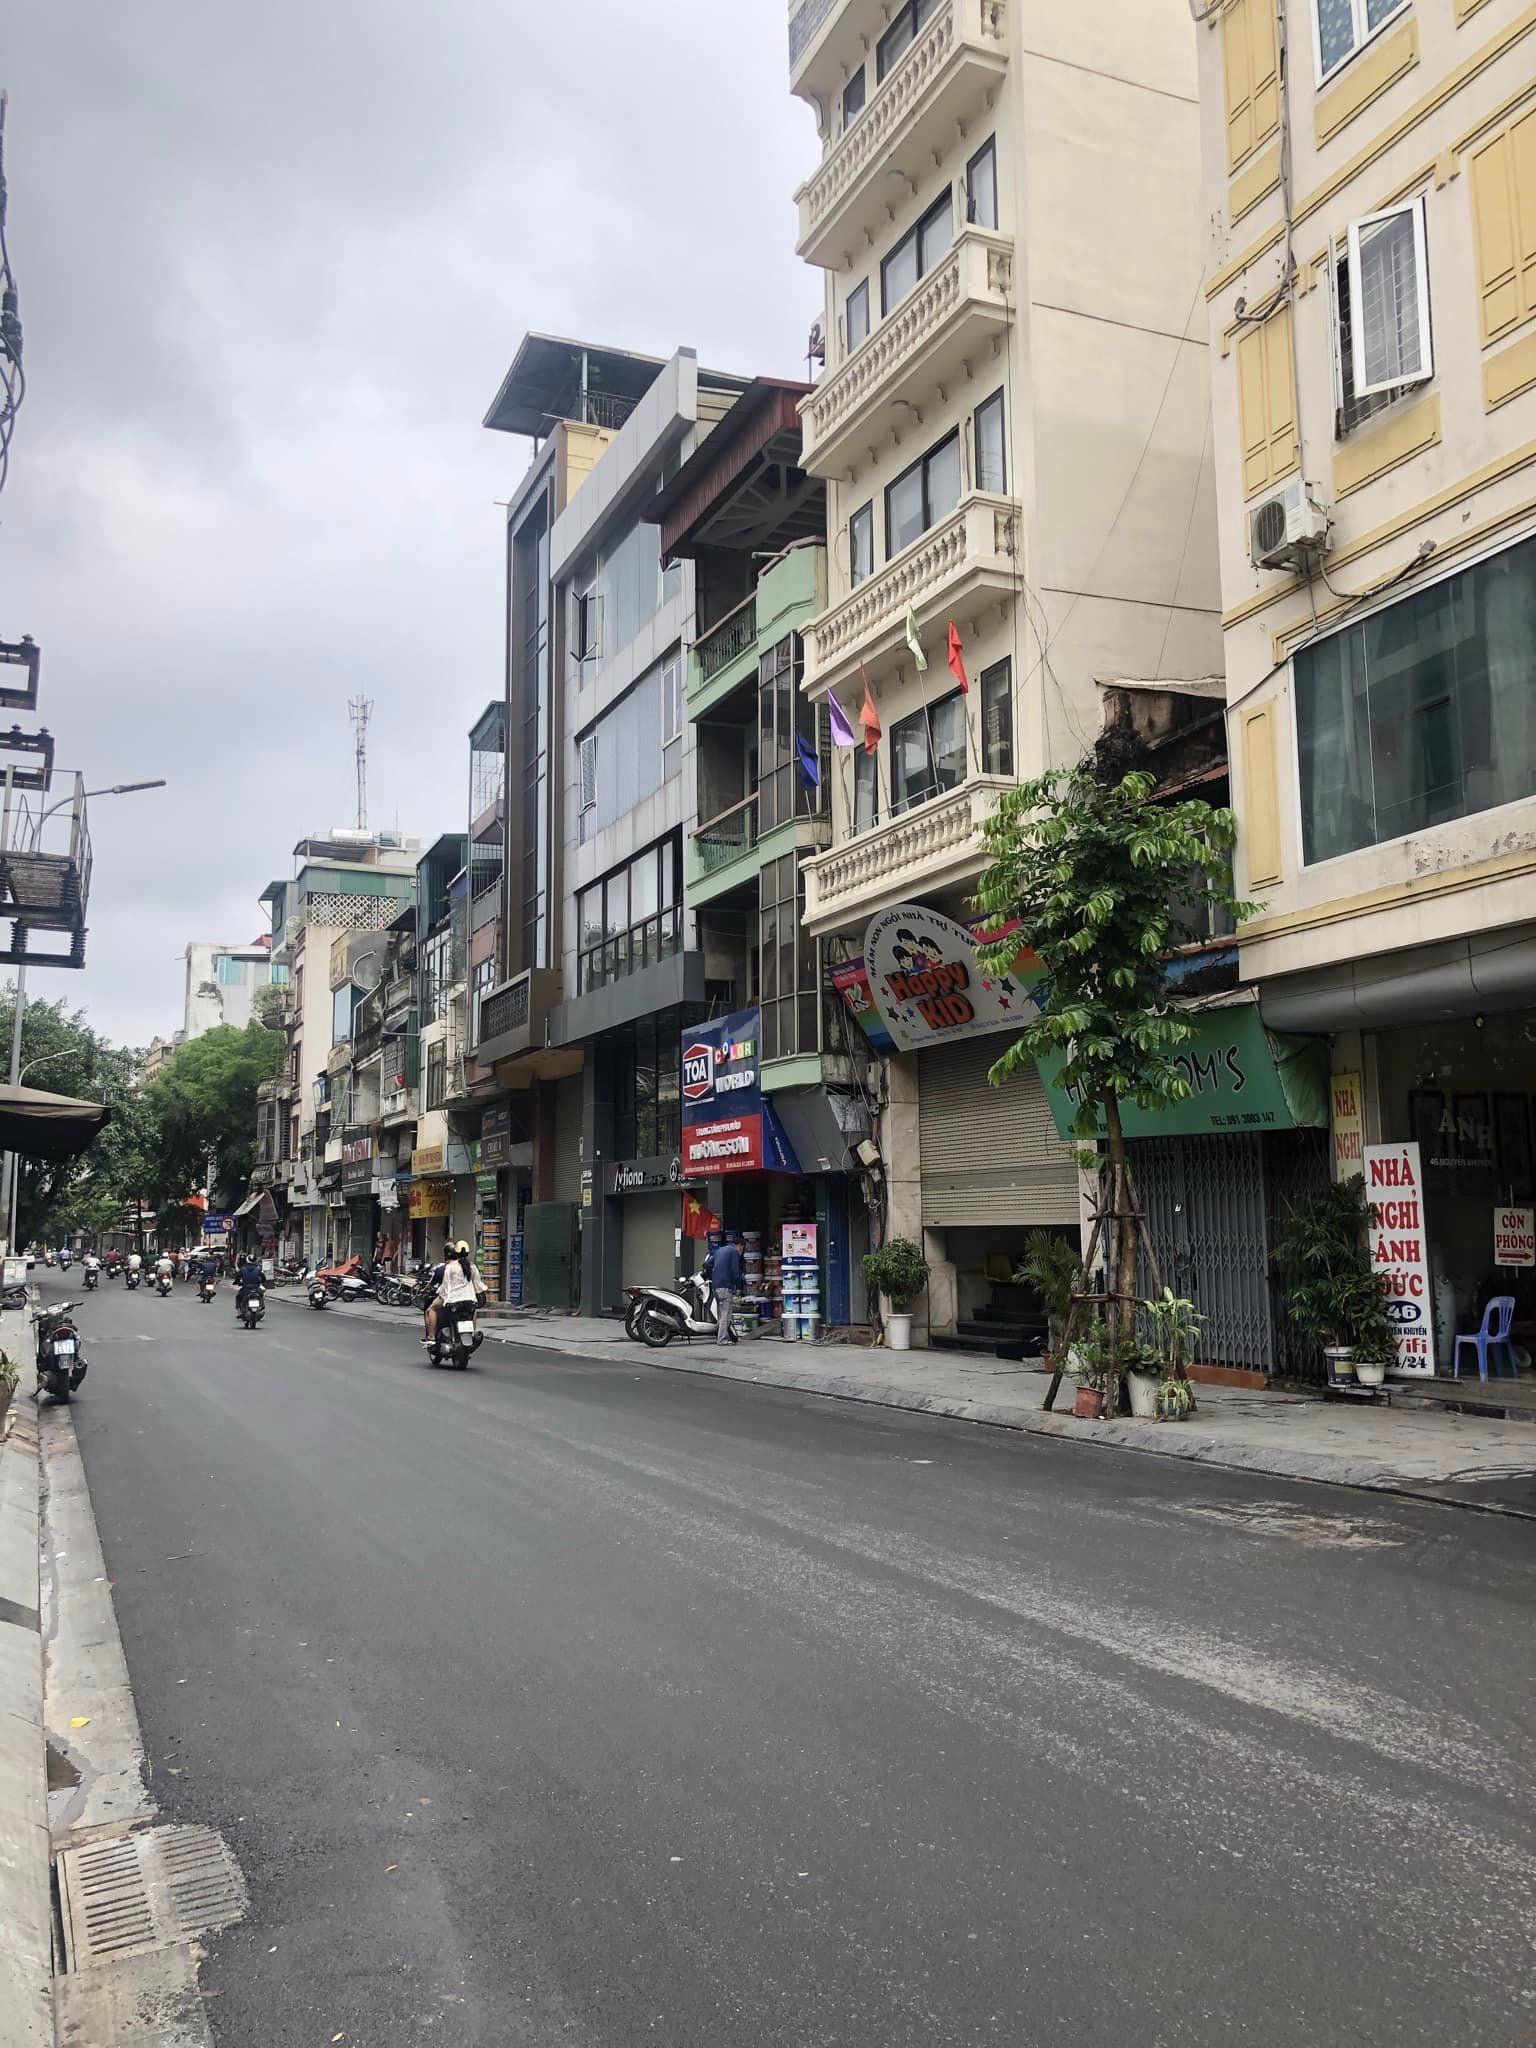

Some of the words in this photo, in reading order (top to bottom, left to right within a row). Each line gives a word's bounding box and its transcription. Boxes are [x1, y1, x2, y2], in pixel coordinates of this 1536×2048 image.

[902, 910, 925, 921] NHÀ
[926, 915, 948, 931] TRÍ
[884, 960, 970, 1001] Happy
[714, 1040, 753, 1064] COLOR
[684, 1058, 706, 1083] TOA
[715, 1070, 755, 1093] WORLD
[1334, 1080, 1357, 1117] NHÀ
[1369, 1149, 1415, 1187] NHÀ
[1369, 1189, 1419, 1230] NGHỈ
[1502, 1211, 1524, 1229] CÒN
[1375, 1234, 1421, 1263] ÁNH
[1496, 1230, 1534, 1249] PHÒNG
[1386, 1304, 1417, 1320] 46
